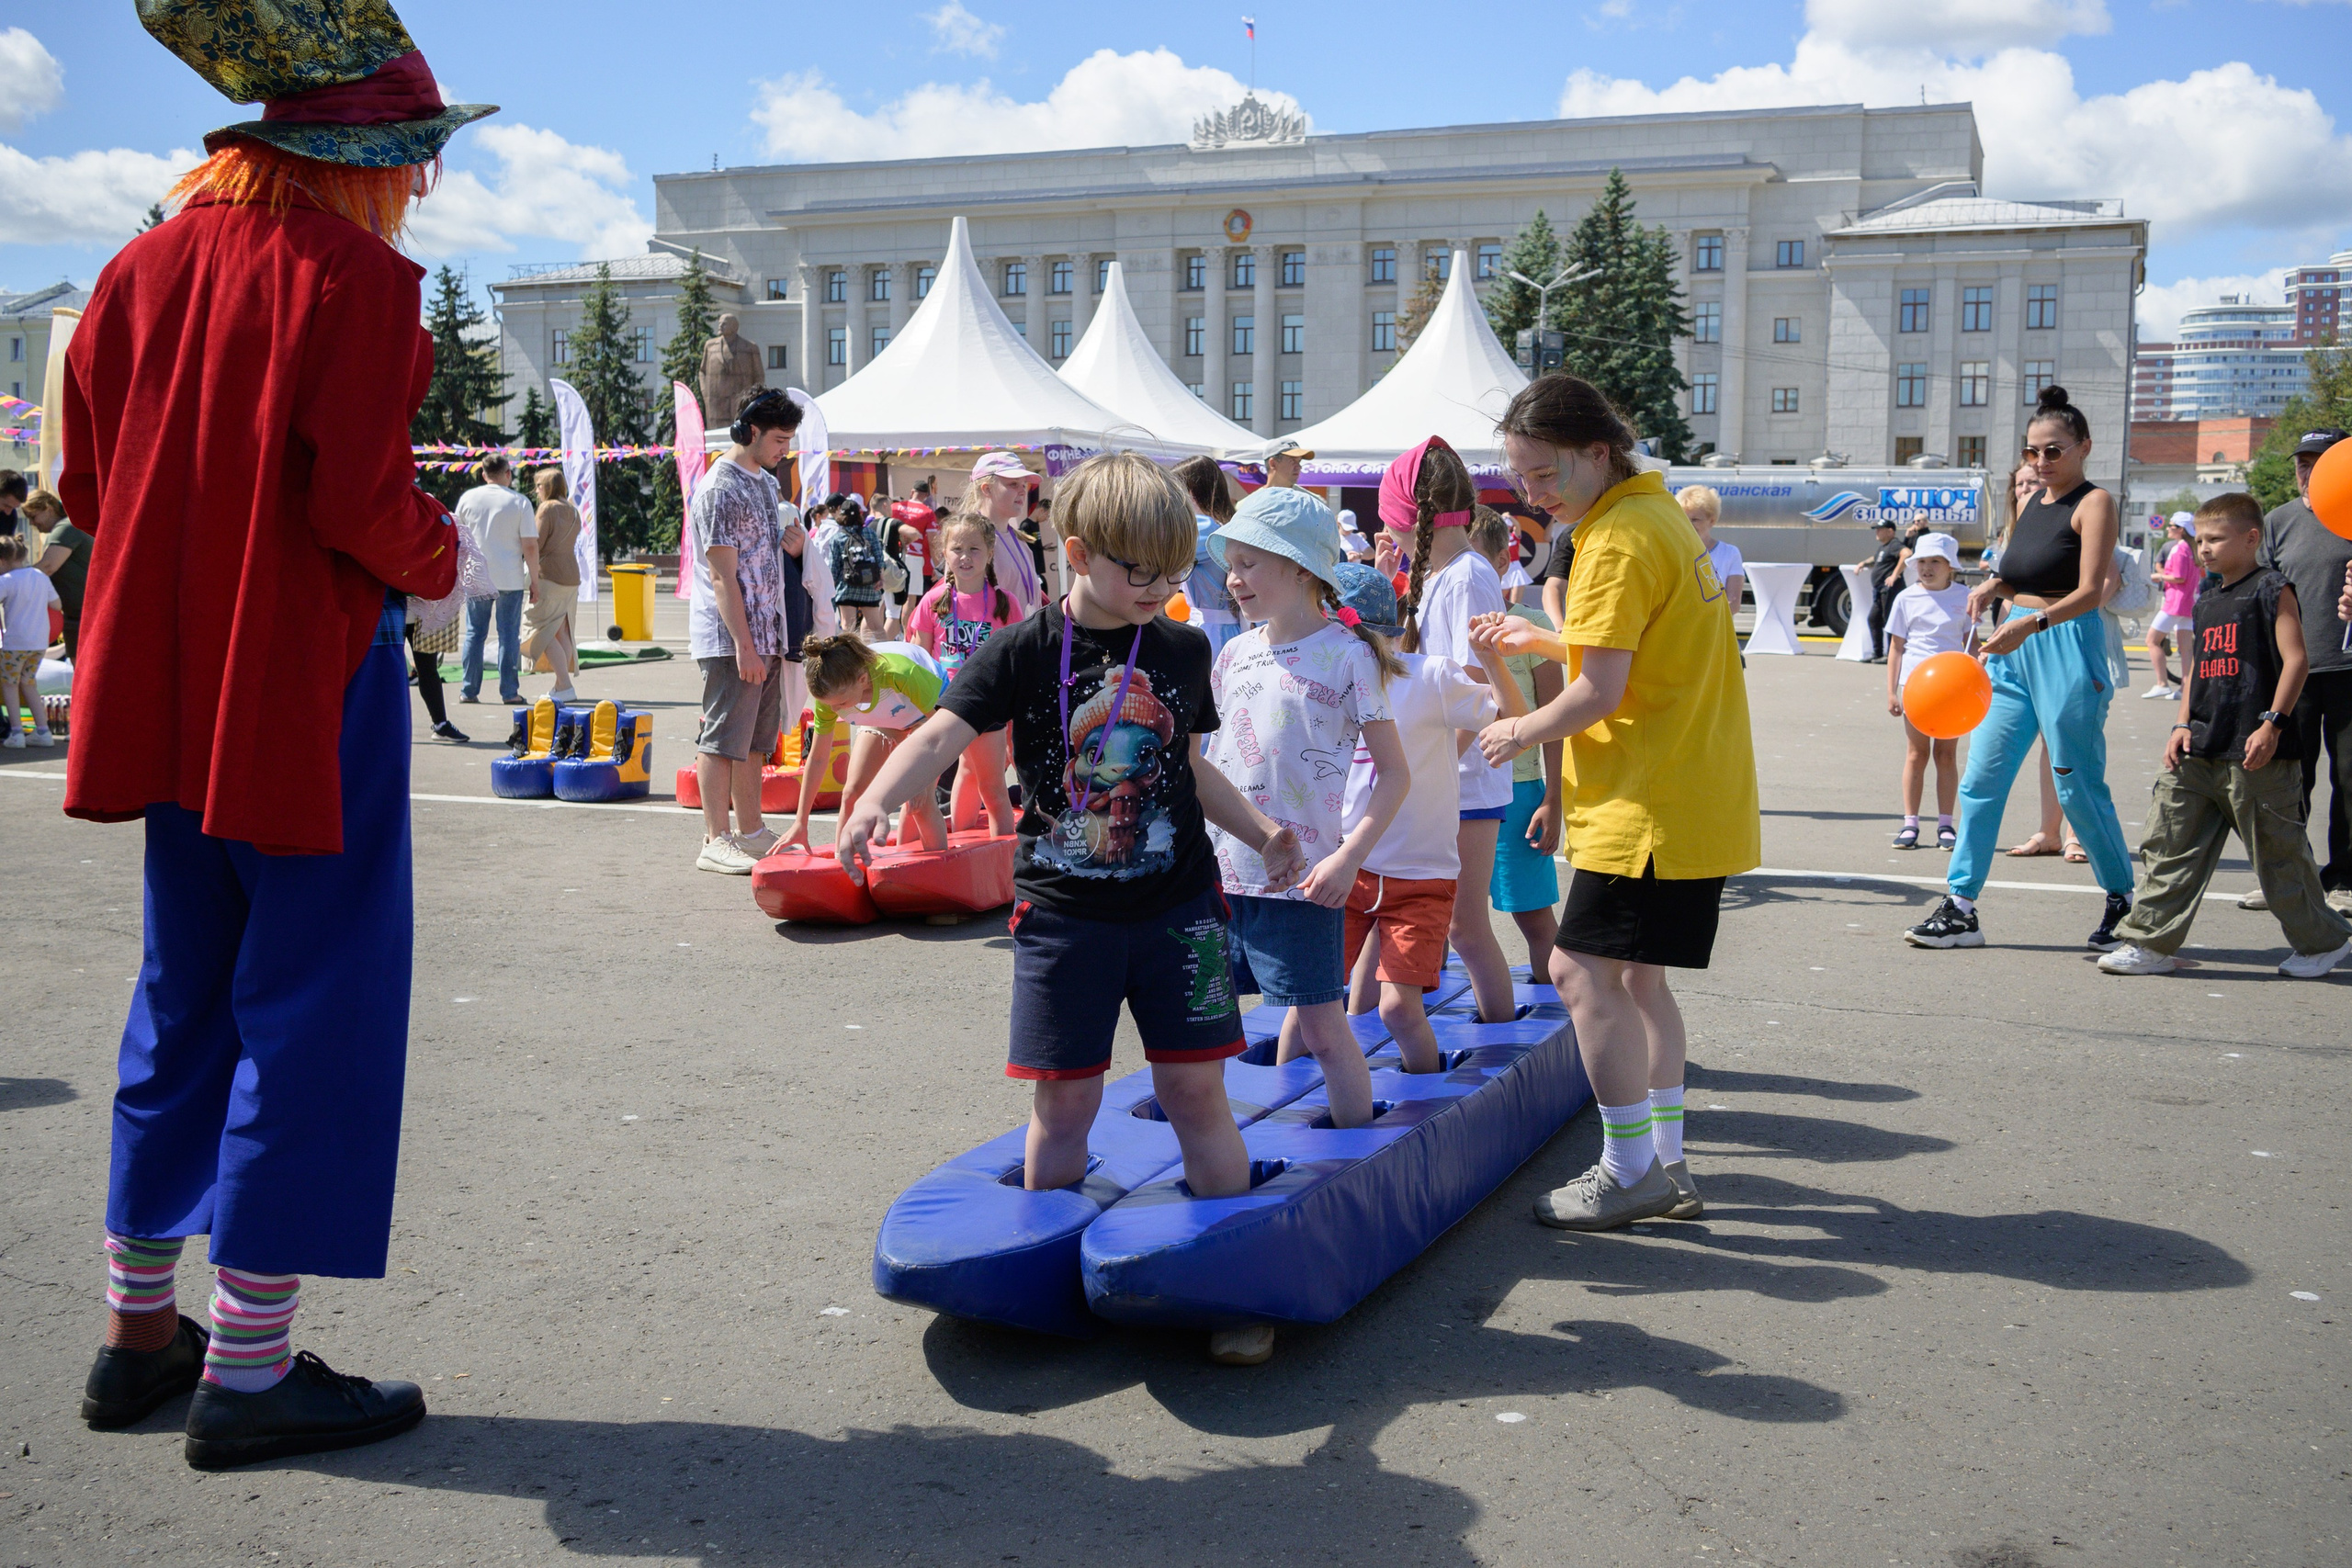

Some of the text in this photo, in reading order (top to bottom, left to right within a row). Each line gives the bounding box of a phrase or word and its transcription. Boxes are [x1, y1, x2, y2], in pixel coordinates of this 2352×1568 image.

[1879, 489, 1977, 508] КЛЮЧ
[1353, 597, 1368, 605] BOY
[2202, 623, 2238, 654] TRY
[1266, 646, 1298, 657] DREAMS
[1256, 659, 1276, 668] TRUE
[2199, 657, 2239, 679] HARD
[1280, 673, 1342, 708] DREAM
[1230, 708, 1265, 768] DREAM
